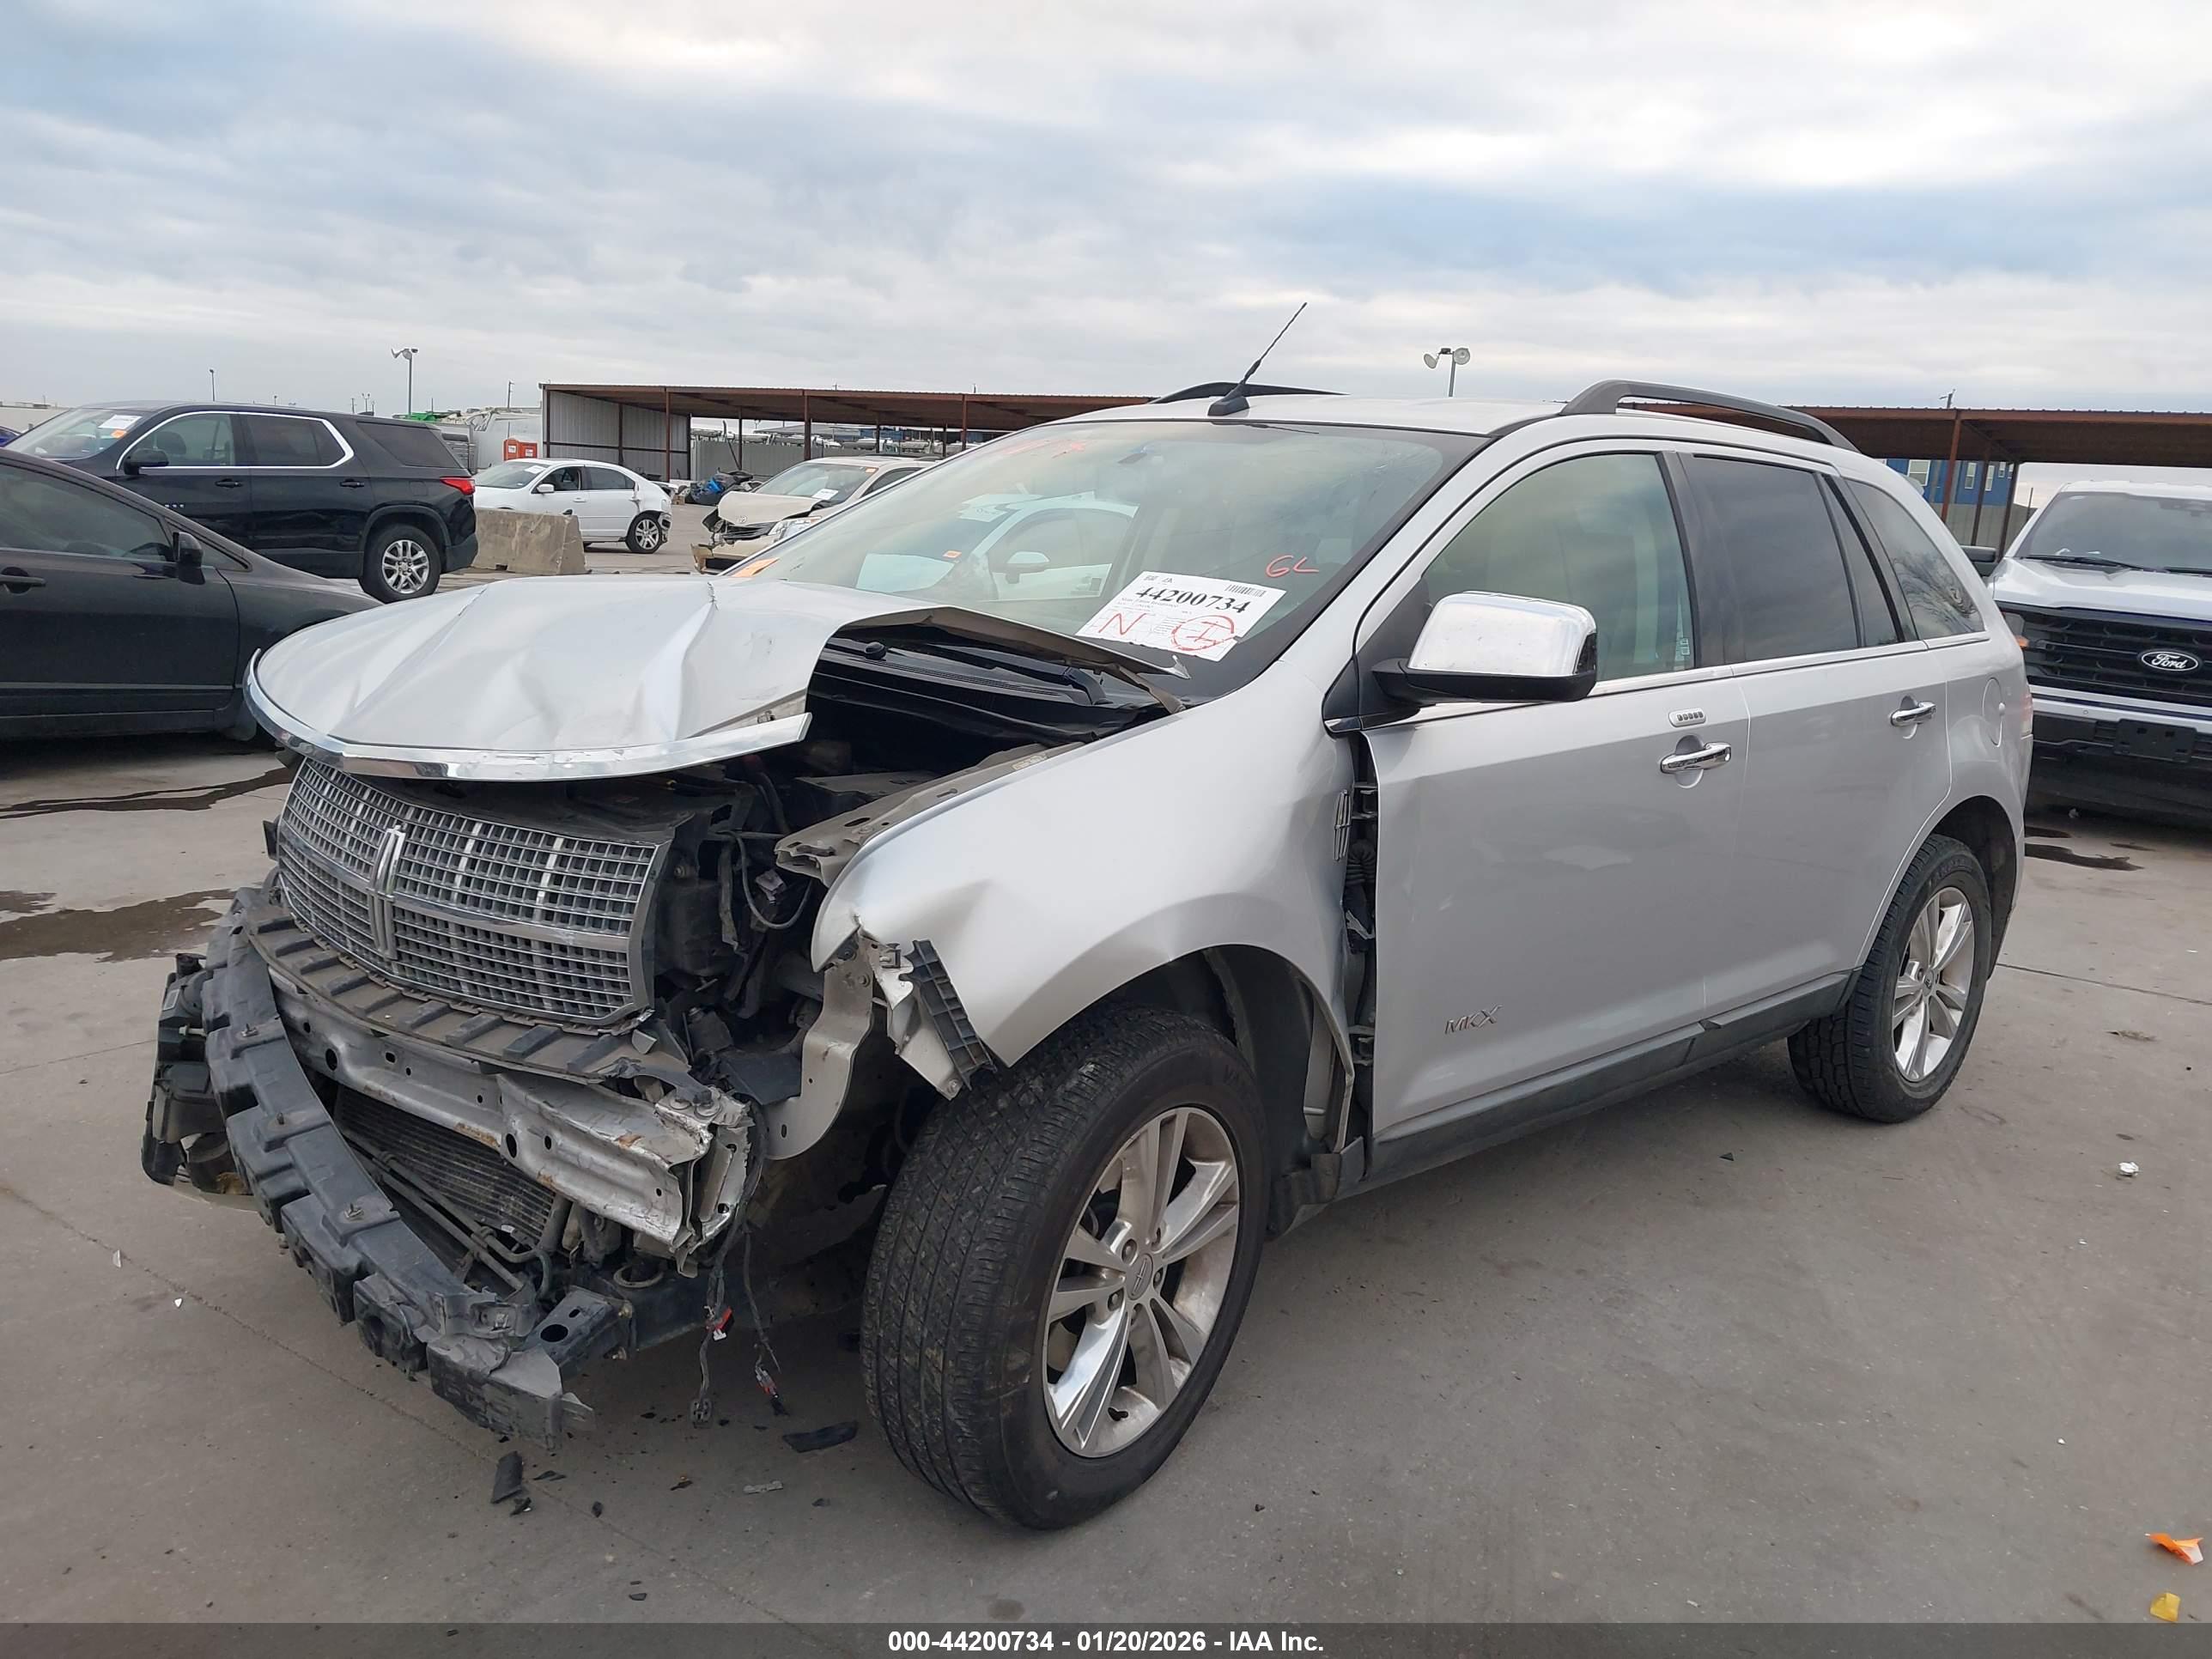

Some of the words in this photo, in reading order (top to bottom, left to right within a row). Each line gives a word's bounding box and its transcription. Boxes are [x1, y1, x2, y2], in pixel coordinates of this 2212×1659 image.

[1134, 586, 1251, 613] 44200734
[1098, 612, 1146, 636] N
[2151, 653, 2188, 669] Ford
[1444, 1003, 1504, 1035] MKX
